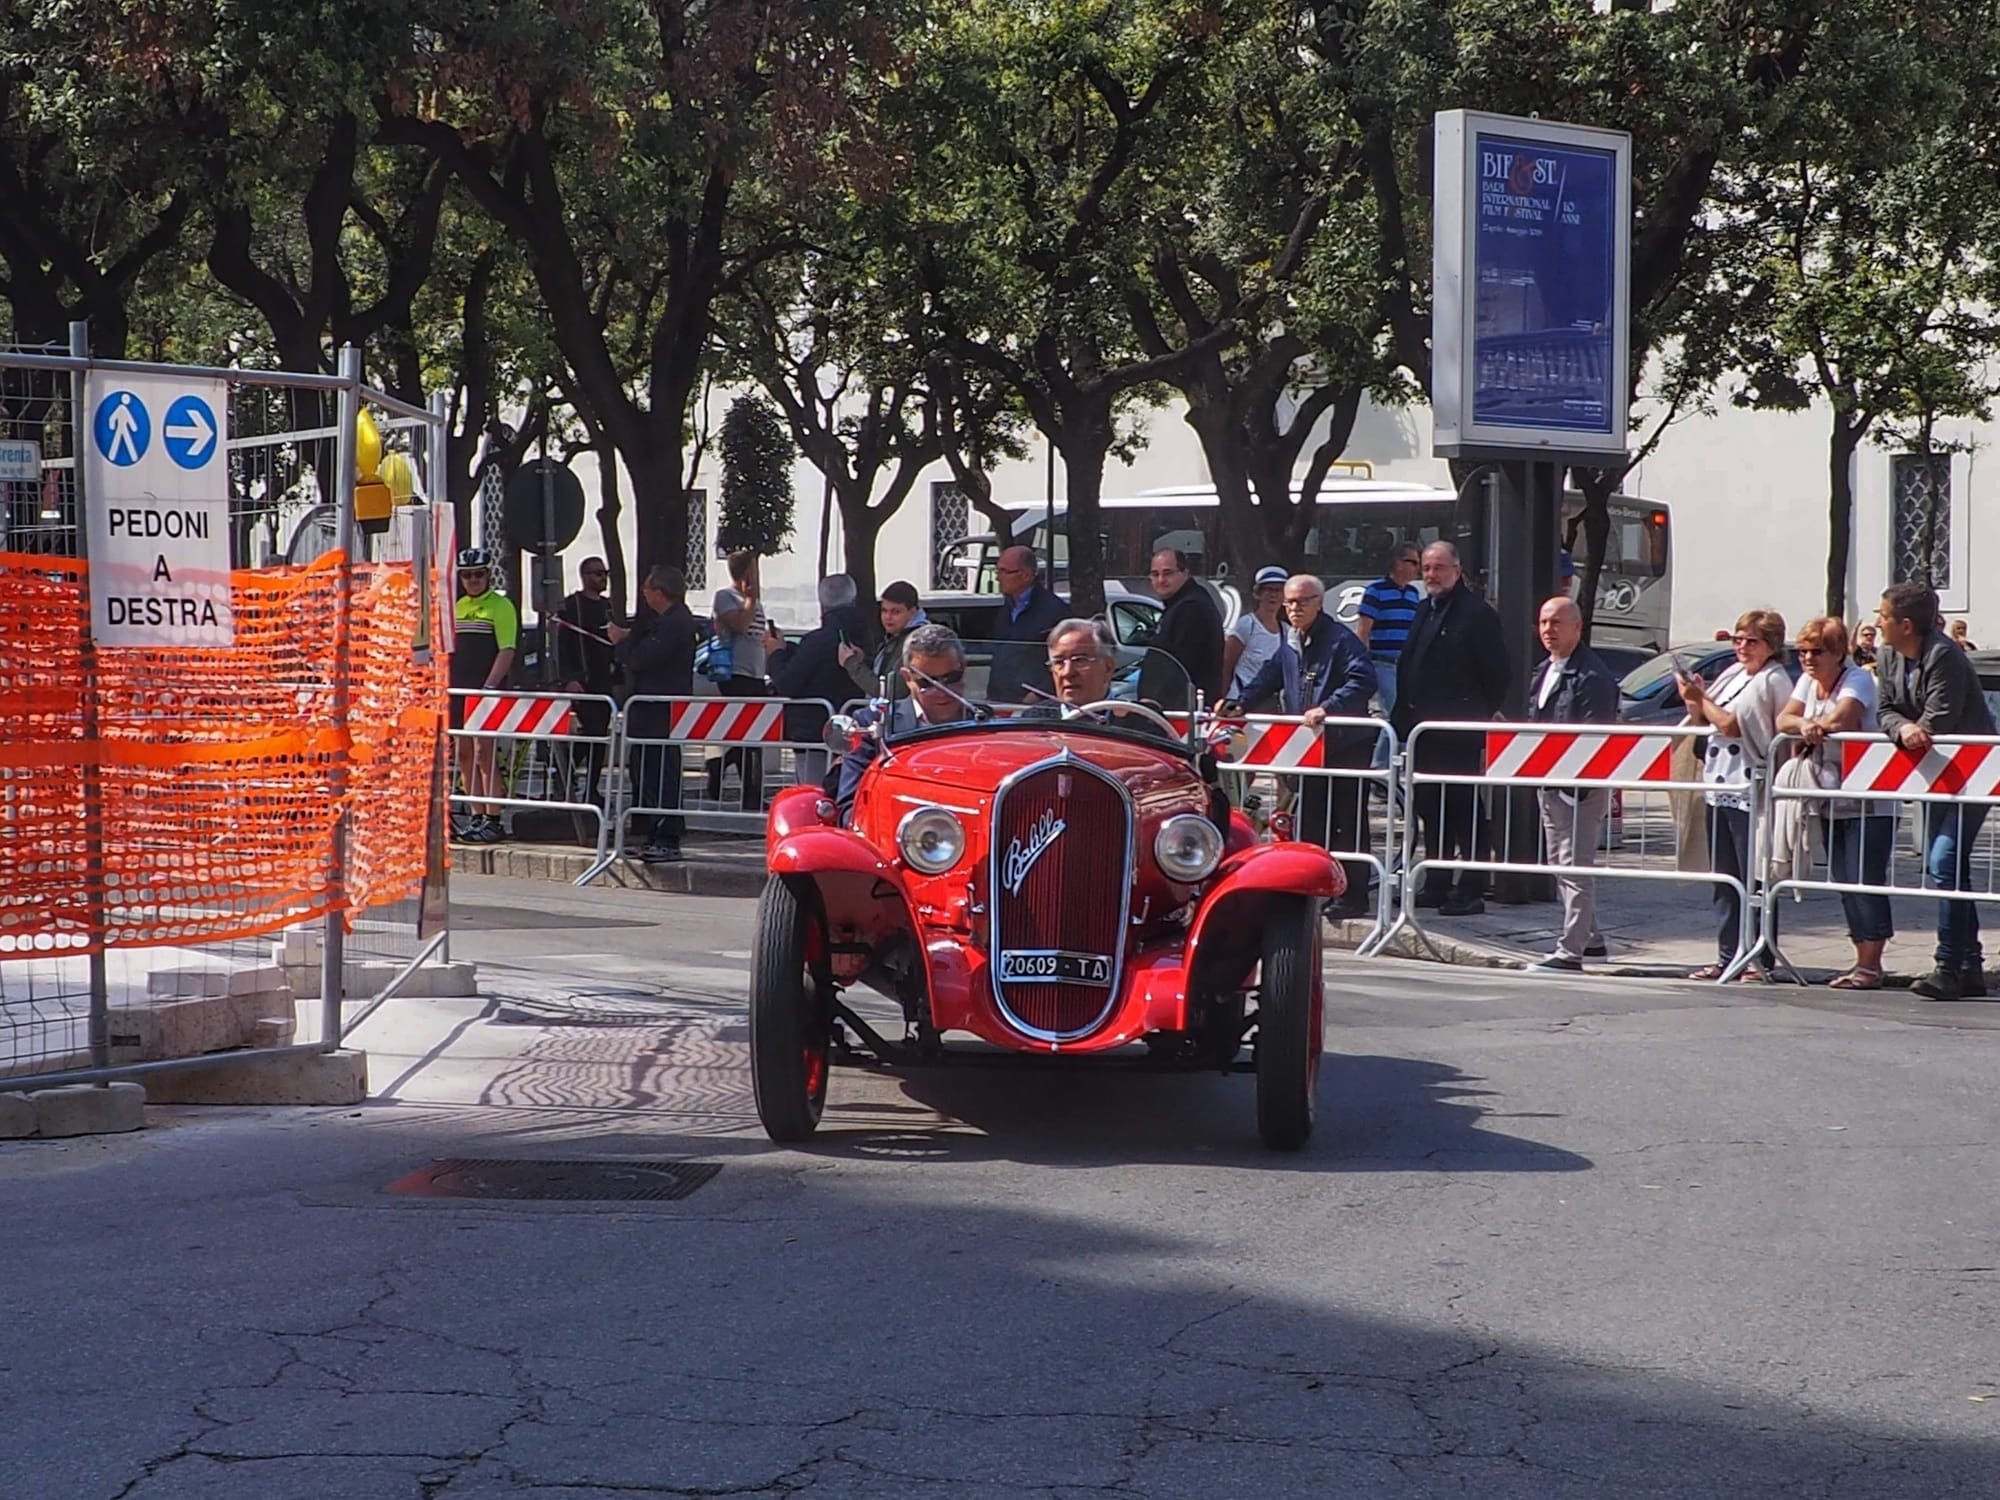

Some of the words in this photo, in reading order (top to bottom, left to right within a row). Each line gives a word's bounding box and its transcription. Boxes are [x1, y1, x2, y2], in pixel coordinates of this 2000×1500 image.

[1482, 193, 1551, 210] INTERNATIONAL
[109, 508, 209, 539] PEDONI
[153, 554, 172, 582] A
[107, 597, 218, 626] DESTRA
[1002, 808, 1067, 898] Balilla
[1006, 957, 1057, 975] 20609
[1077, 958, 1105, 979] TA
